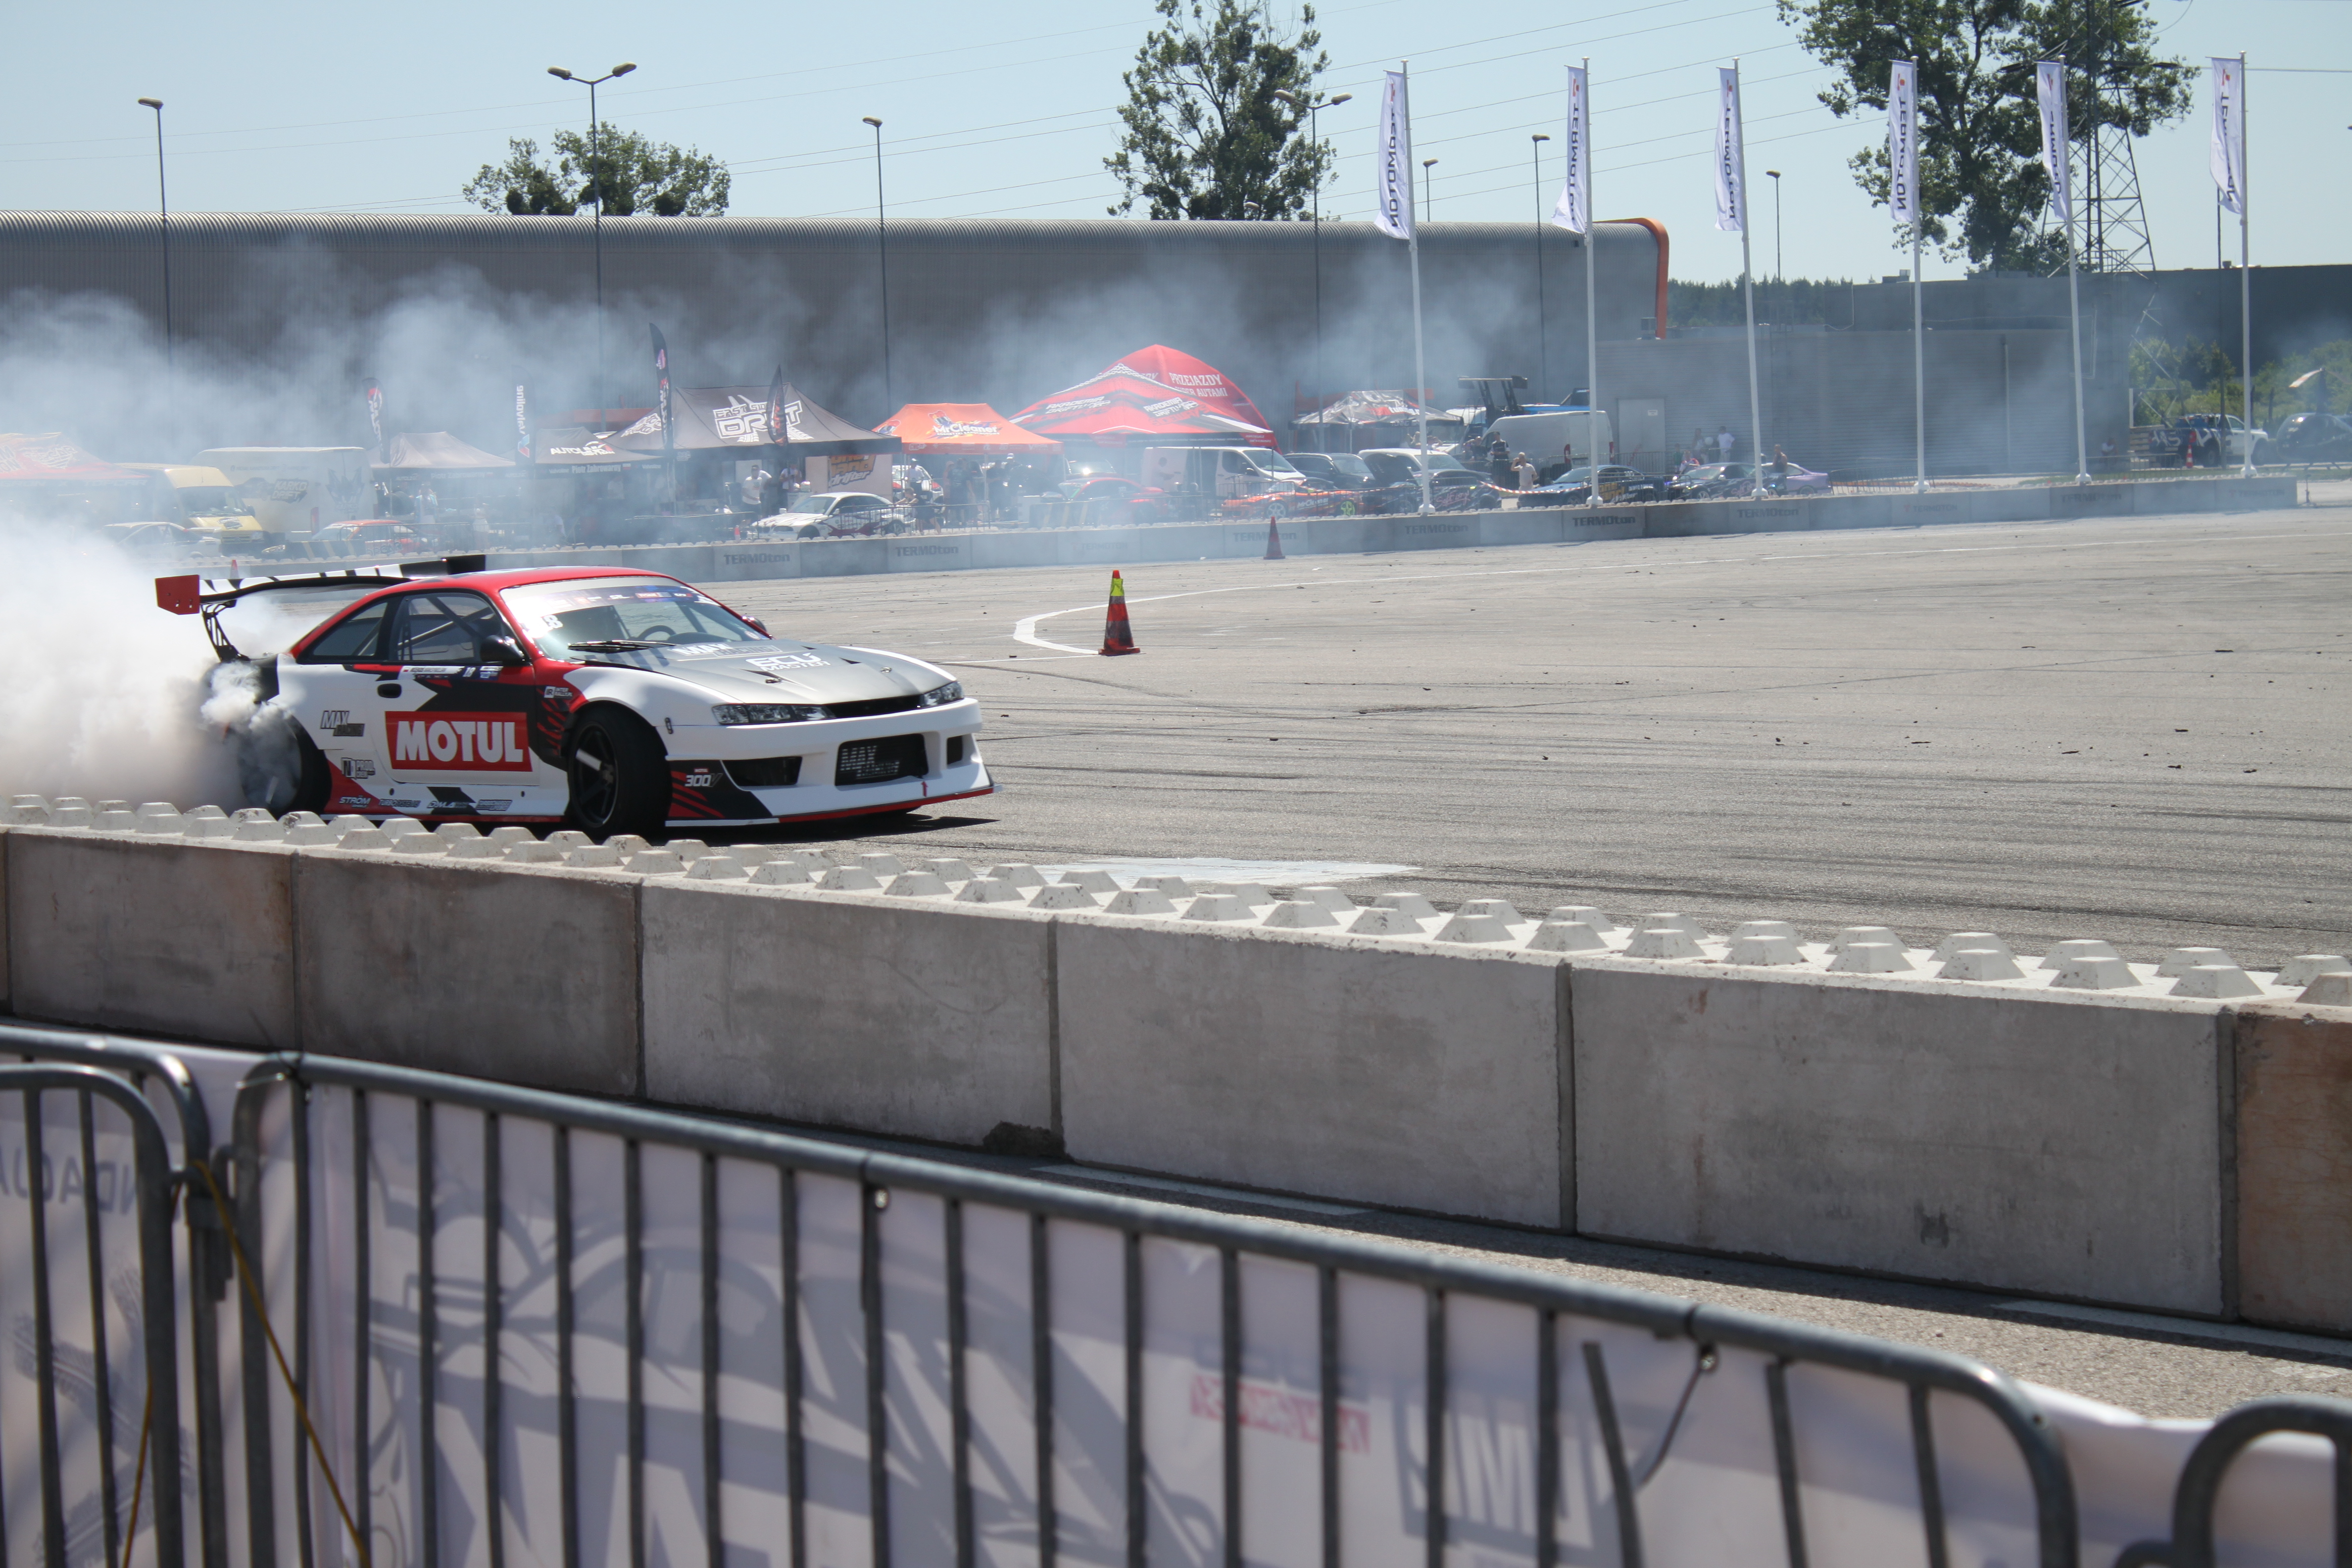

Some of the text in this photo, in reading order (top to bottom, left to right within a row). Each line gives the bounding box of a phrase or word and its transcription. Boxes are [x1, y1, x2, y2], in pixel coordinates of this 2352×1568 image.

[1169, 373, 1223, 386] PRZEJAZDY
[1196, 388, 1228, 397] AUTAMI
[1045, 396, 1105, 410] AKADEMIA
[1143, 397, 1183, 412] AKADEMIA
[716, 405, 747, 418] EAST
[719, 404, 799, 436] DRT
[933, 423, 998, 433] MrCleaner
[275, 481, 308, 491] KARKO
[272, 490, 300, 500] DRIFT
[1737, 508, 1799, 518] TERMOton
[1573, 516, 1636, 527] TERMOton
[1405, 524, 1469, 535] TERMOton
[1233, 532, 1297, 542] TERMon
[895, 545, 959, 557] TERMOton
[723, 553, 790, 565] TERMOton
[760, 661, 831, 672] MASTER
[321, 711, 349, 729] MAX
[396, 721, 523, 763] MOTUL
[840, 745, 878, 771] MAX
[339, 795, 371, 804] STRÖM
